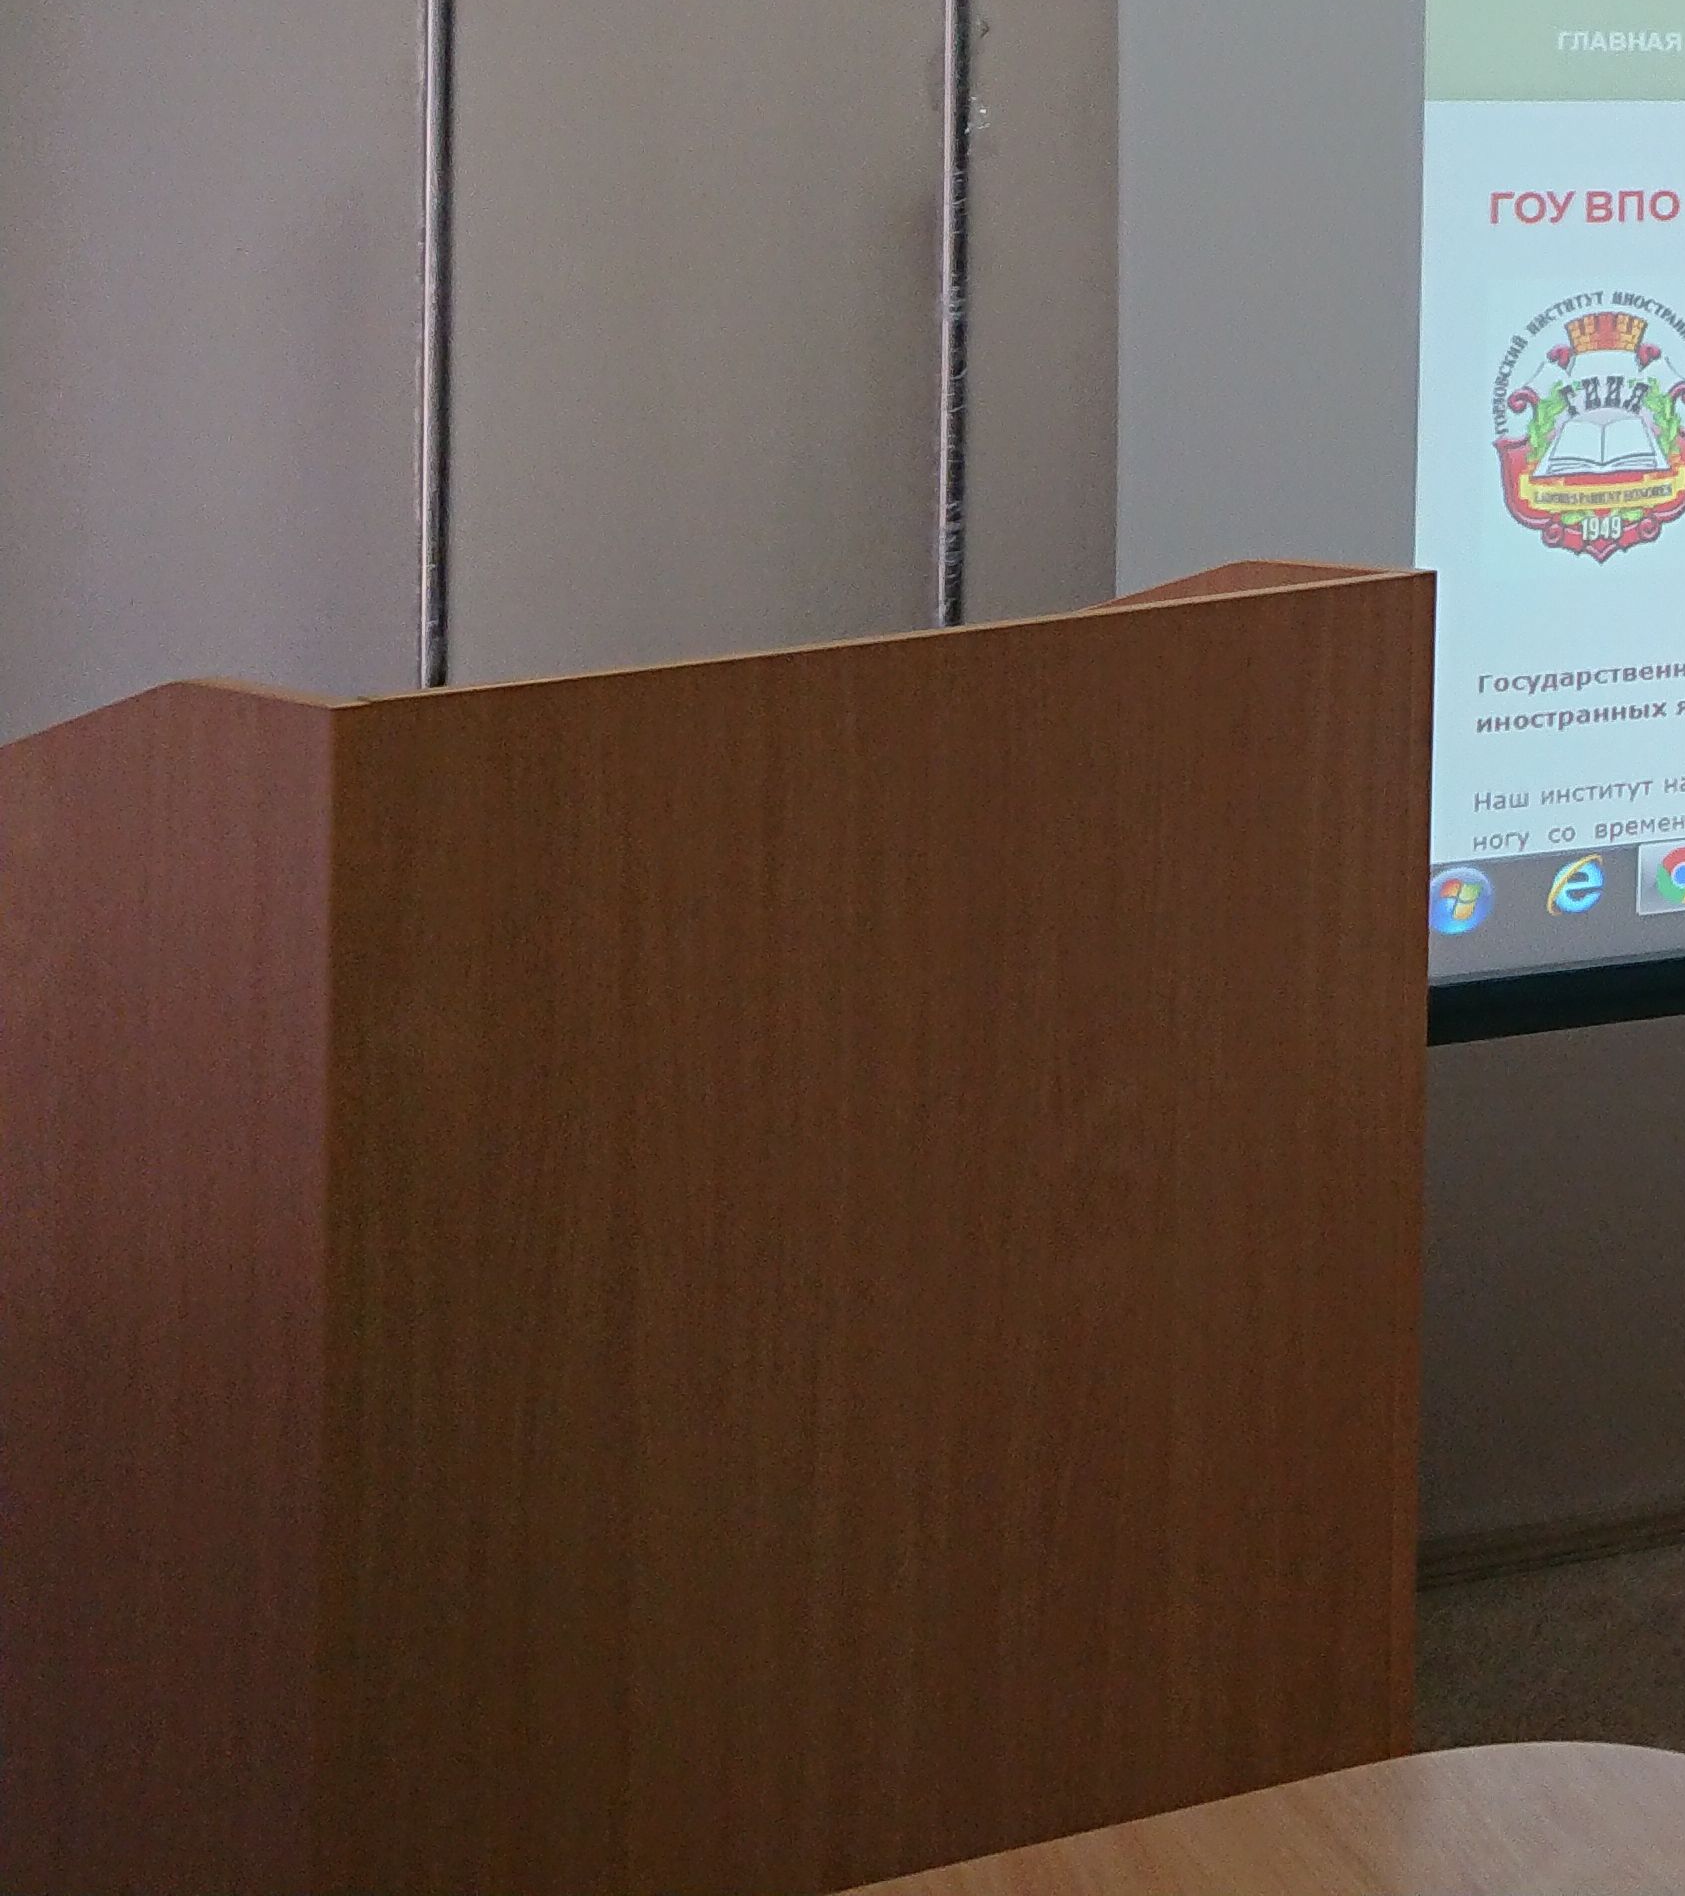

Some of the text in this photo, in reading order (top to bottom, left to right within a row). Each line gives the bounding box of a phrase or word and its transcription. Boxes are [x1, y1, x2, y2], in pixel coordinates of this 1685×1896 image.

[1558, 30, 1682, 53] ГЛАВНАЯ
[1490, 191, 1575, 224] ГОУ
[1586, 190, 1680, 223] ВПО
[1581, 516, 1622, 541] 1949
[1476, 698, 1667, 734] иностранных
[1474, 790, 1529, 813] Наш
[1541, 778, 1653, 808] институт
[1473, 829, 1529, 852] ногу
[1548, 824, 1576, 843] со
